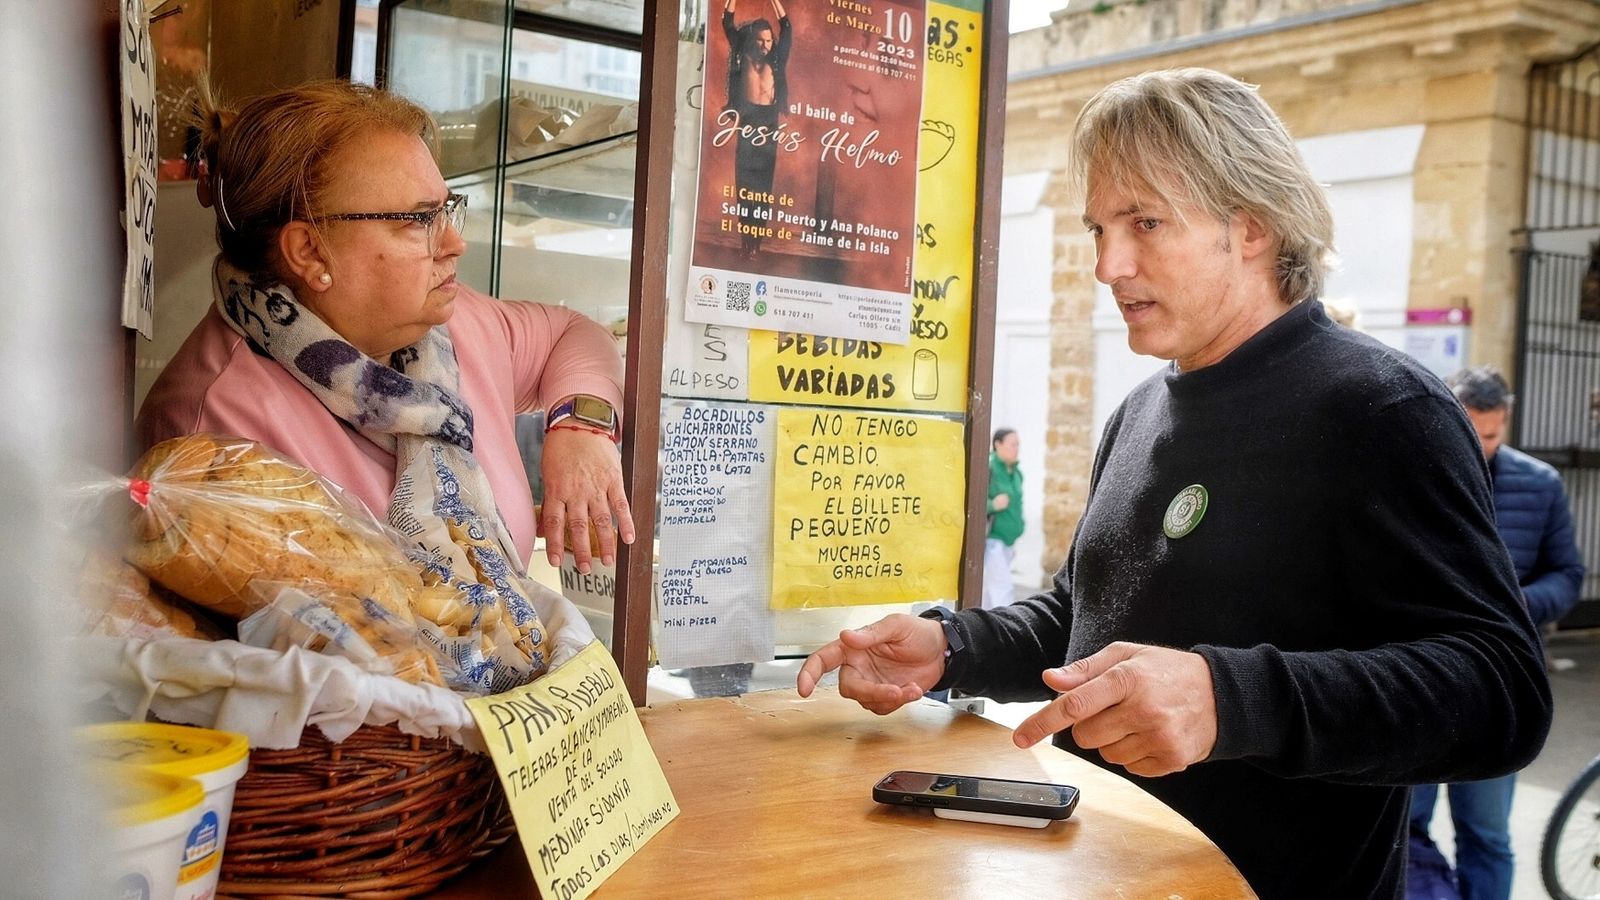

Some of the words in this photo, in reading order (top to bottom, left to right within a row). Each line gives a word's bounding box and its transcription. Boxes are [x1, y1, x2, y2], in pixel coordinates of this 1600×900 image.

[829, 0, 872, 15] Viernes
[827, 12, 841, 25] de
[845, 15, 882, 35] Marzo
[883, 8, 912, 44] 10
[839, 45, 860, 57] partir
[877, 41, 915, 59] 2023
[833, 56, 867, 70] Reservas
[876, 65, 889, 76] 618
[890, 69, 903, 79] 707
[790, 102, 801, 115] el
[806, 104, 837, 123] baile
[840, 113, 855, 126] de
[712, 109, 806, 153] Jesús
[820, 128, 904, 169] Helmo
[723, 185, 734, 198] El
[739, 187, 775, 204] Cante
[779, 194, 794, 207] de
[721, 202, 749, 217] Selu
[753, 206, 773, 220] del
[777, 210, 817, 228] Puerto
[820, 219, 828, 232] y
[830, 219, 852, 233] Ana
[856, 223, 900, 240] Polanco
[721, 219, 732, 232] El
[737, 222, 773, 238] toque
[777, 227, 792, 240] de
[800, 231, 834, 246] Jaime
[837, 236, 852, 249] de
[855, 238, 866, 251] la
[870, 241, 890, 255] Isla
[774, 285, 823, 299] flamencoperla
[773, 308, 786, 316] 618
[788, 310, 800, 319] 707
[776, 365, 896, 399] VARIADAS
[683, 407, 765, 424] BOCADILLOS
[811, 414, 843, 437] NO
[856, 416, 918, 437] TENGO
[666, 420, 752, 435] CHICHARRONES
[709, 438, 758, 449] SERRANO
[663, 474, 708, 487] CHORIZO
[664, 464, 707, 476] CHOPED
[710, 464, 721, 473] DE
[811, 471, 842, 491] POR
[853, 473, 906, 491] FAVOR
[824, 497, 845, 515] EL
[852, 494, 921, 516] BILLETE
[663, 515, 717, 525] MORTADELA
[790, 516, 891, 541] PEQUEÑO
[691, 556, 748, 569] EMPANADAS
[818, 545, 881, 564] MUCHAS
[832, 561, 904, 580] GRACIAS
[661, 578, 693, 589] CARNE
[663, 595, 709, 606] VEGETAL
[548, 667, 615, 712] PUEBLO
[488, 692, 557, 755] PAN
[553, 703, 575, 726] DE
[565, 759, 578, 786] DE
[548, 786, 577, 823] VENTA
